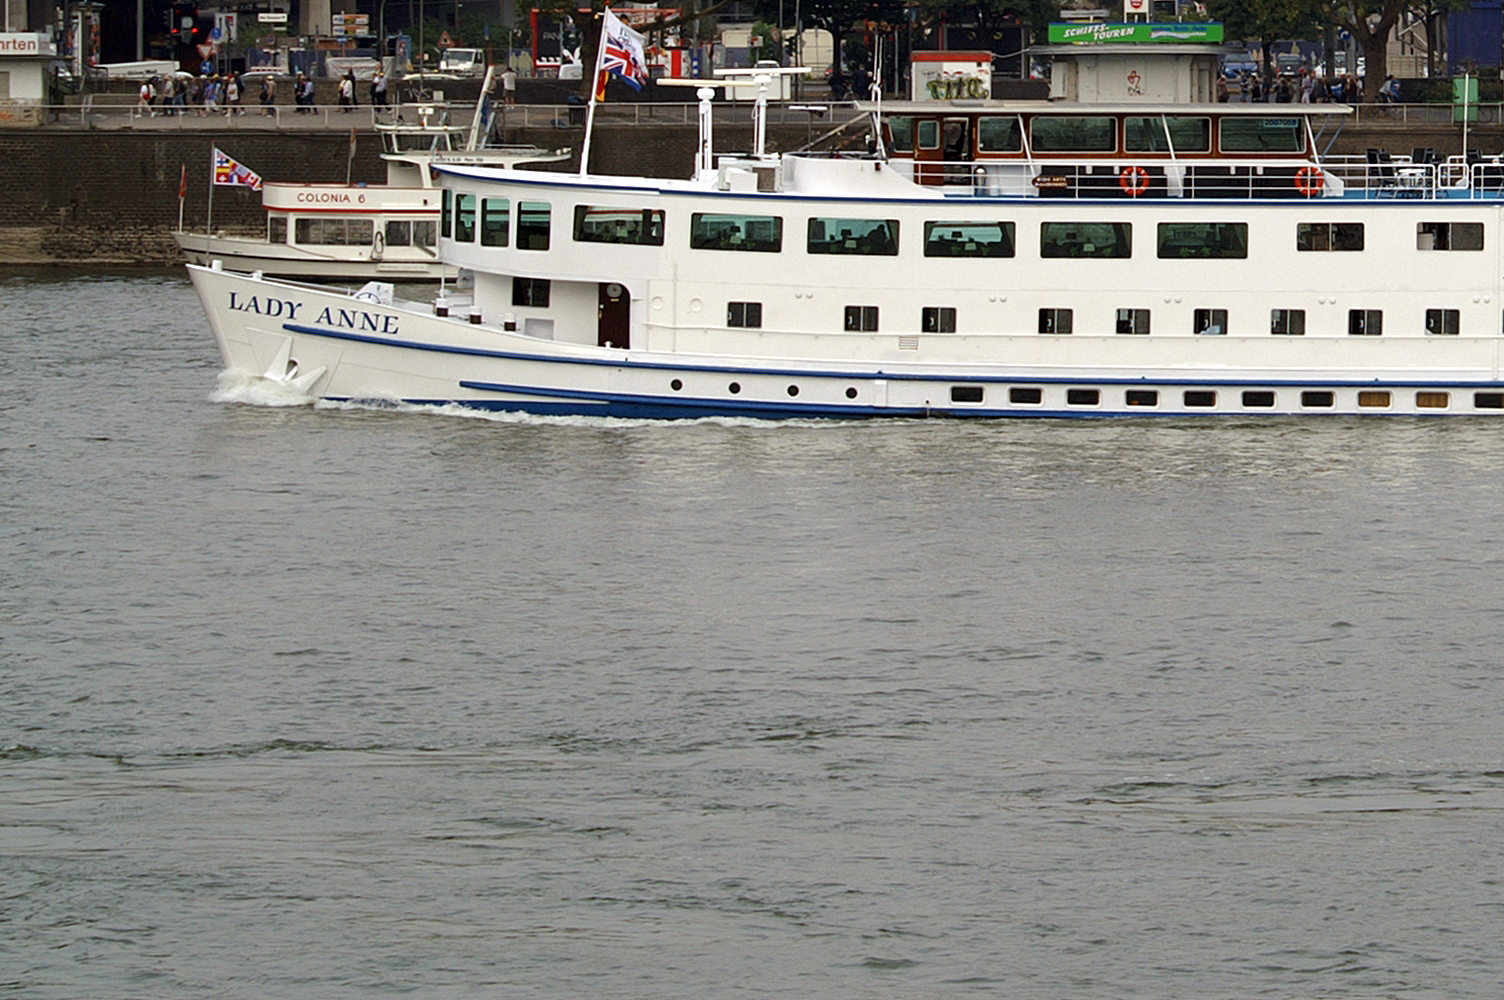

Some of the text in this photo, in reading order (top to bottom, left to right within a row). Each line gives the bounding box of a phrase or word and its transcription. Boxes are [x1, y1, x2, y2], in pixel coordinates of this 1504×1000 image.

[1093, 26, 1135, 41] TOUREN
[296, 192, 366, 204] COLONIA 6
[228, 291, 400, 335] LADY ANNE
